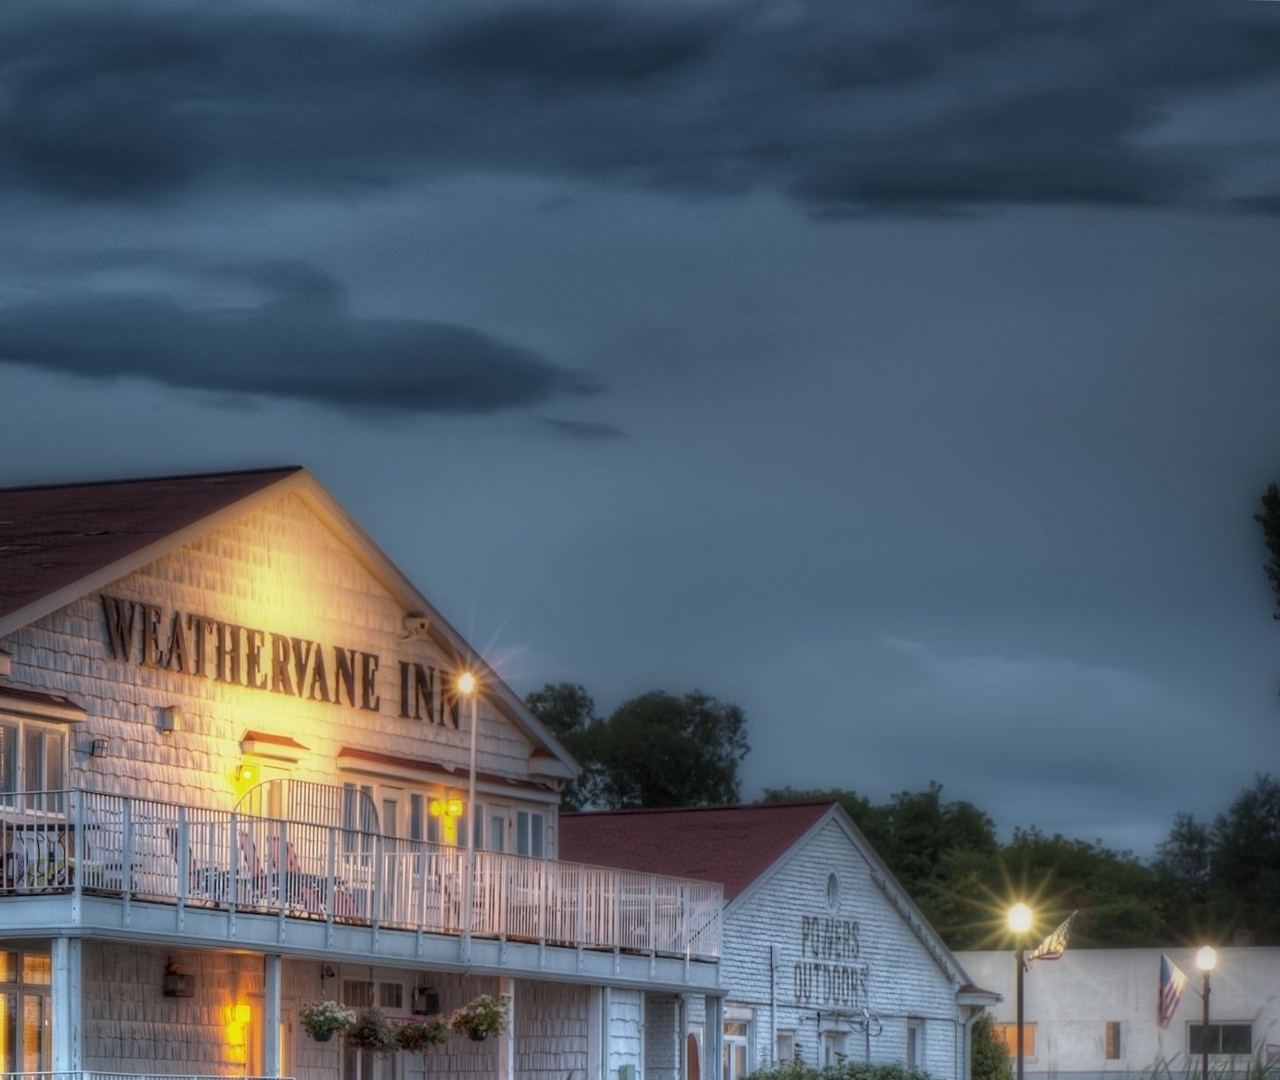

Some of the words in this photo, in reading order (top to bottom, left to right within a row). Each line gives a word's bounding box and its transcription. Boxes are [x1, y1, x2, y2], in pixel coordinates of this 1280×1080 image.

[100, 594, 382, 713] WEATHERVANE
[397, 660, 461, 730] INN
[802, 916, 860, 959] POWERS
[794, 962, 867, 1008] OUTDOORS
